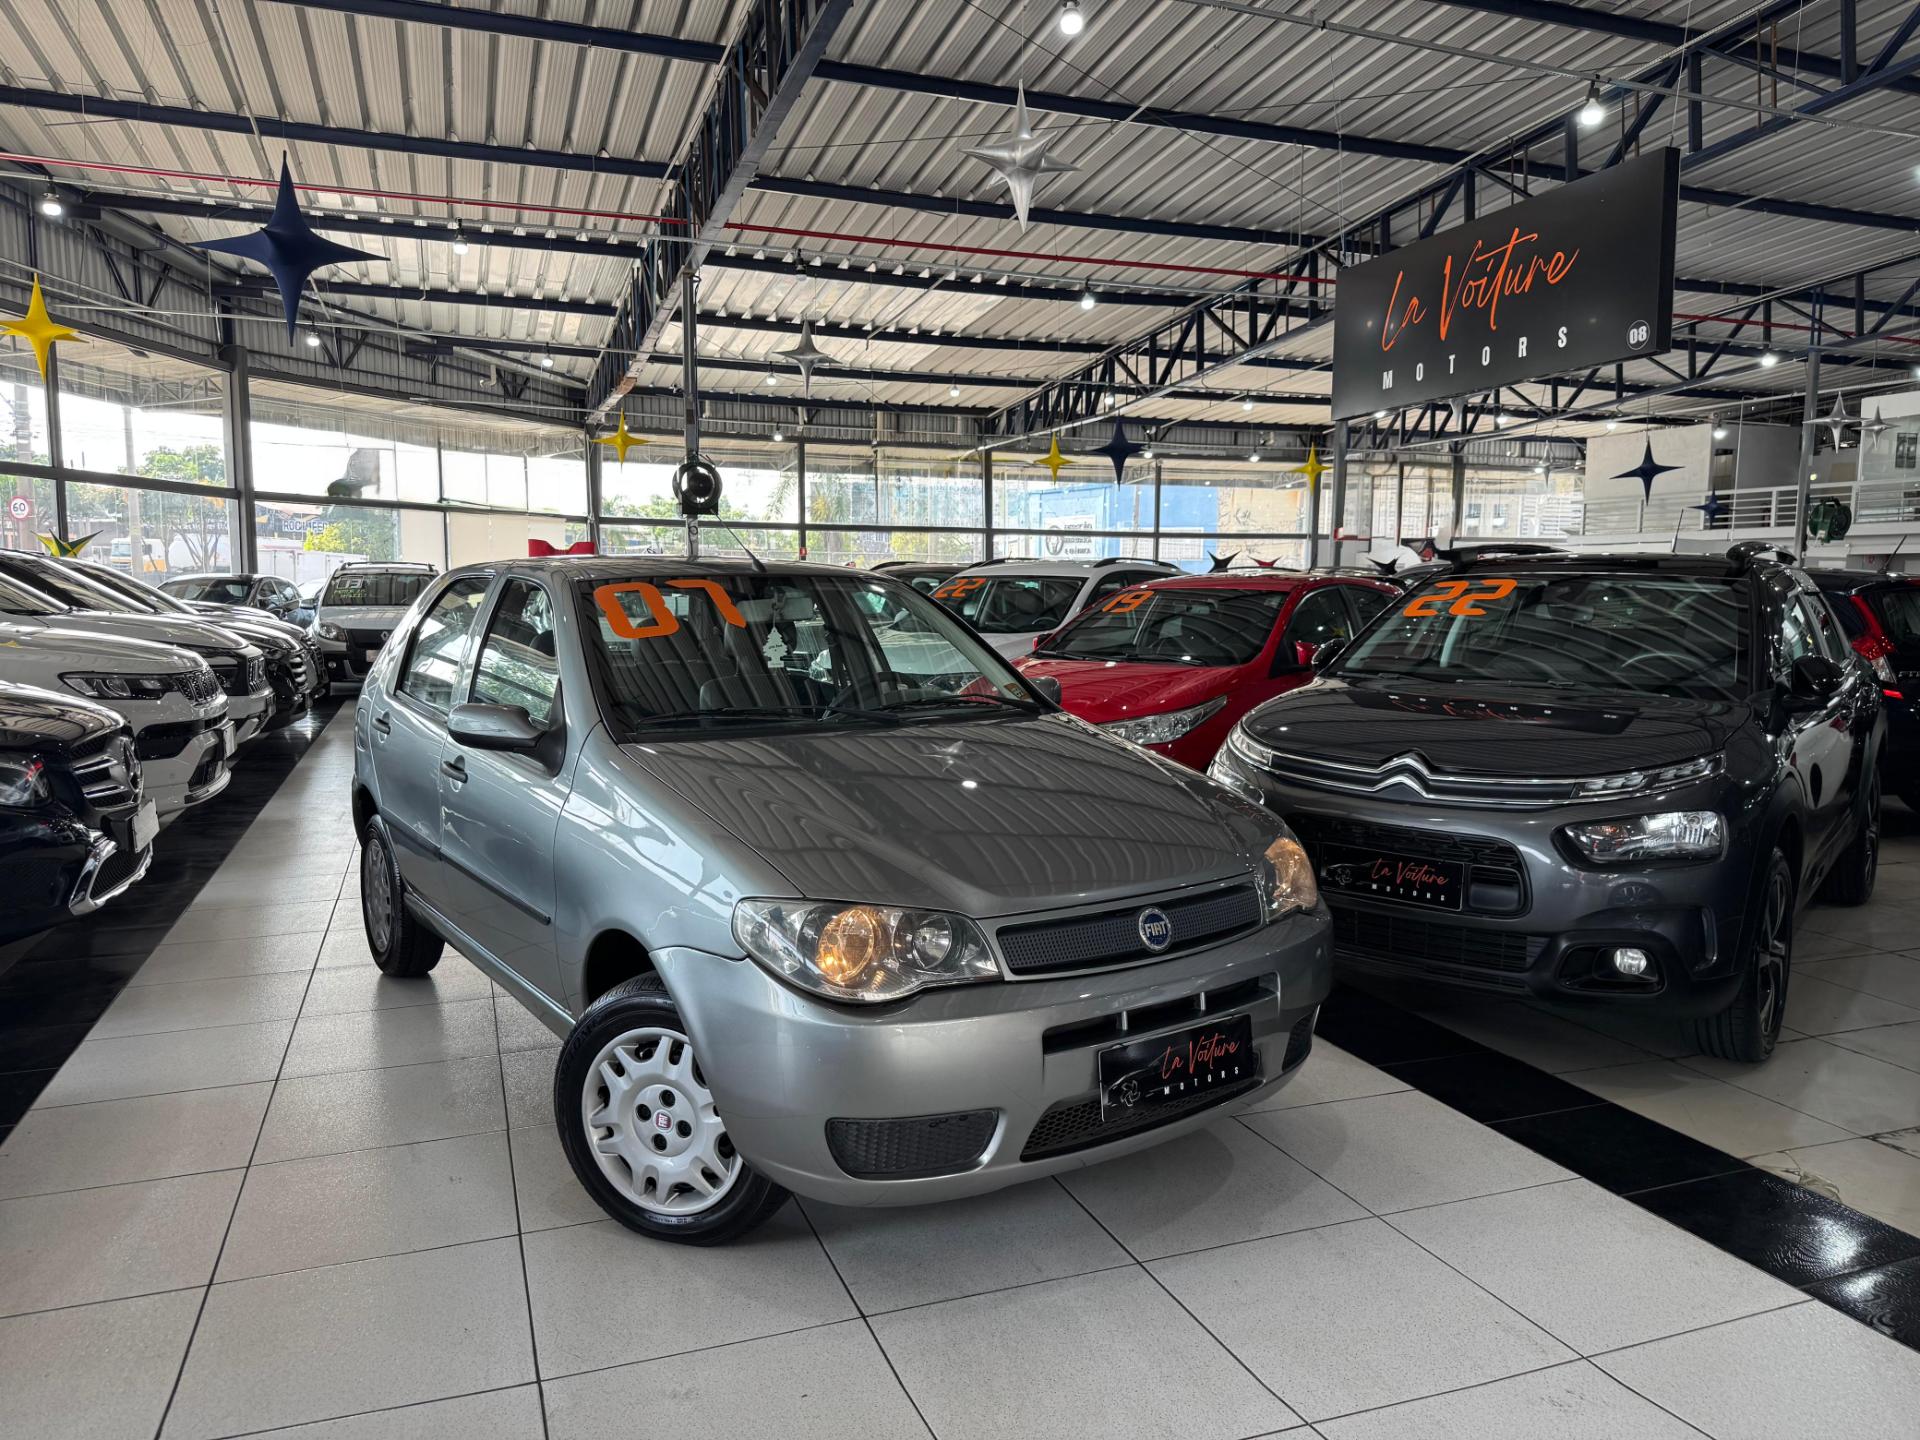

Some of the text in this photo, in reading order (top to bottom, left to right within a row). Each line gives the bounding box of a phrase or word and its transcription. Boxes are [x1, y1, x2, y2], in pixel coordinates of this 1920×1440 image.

[1381, 227, 1580, 351] La Voiture
[1629, 325, 1648, 343] 08
[1382, 326, 1568, 390] MOTORS
[13, 502, 26, 512] 60
[934, 578, 987, 598] 22
[1402, 578, 1518, 617] 22
[1102, 590, 1155, 613] 19
[1371, 858, 1449, 888] La Voiture
[1371, 883, 1446, 902] MOTORS
[1144, 921, 1167, 937] FIAT
[1161, 1032, 1240, 1080] La Voiture
[1163, 1066, 1240, 1096] MOTORS
